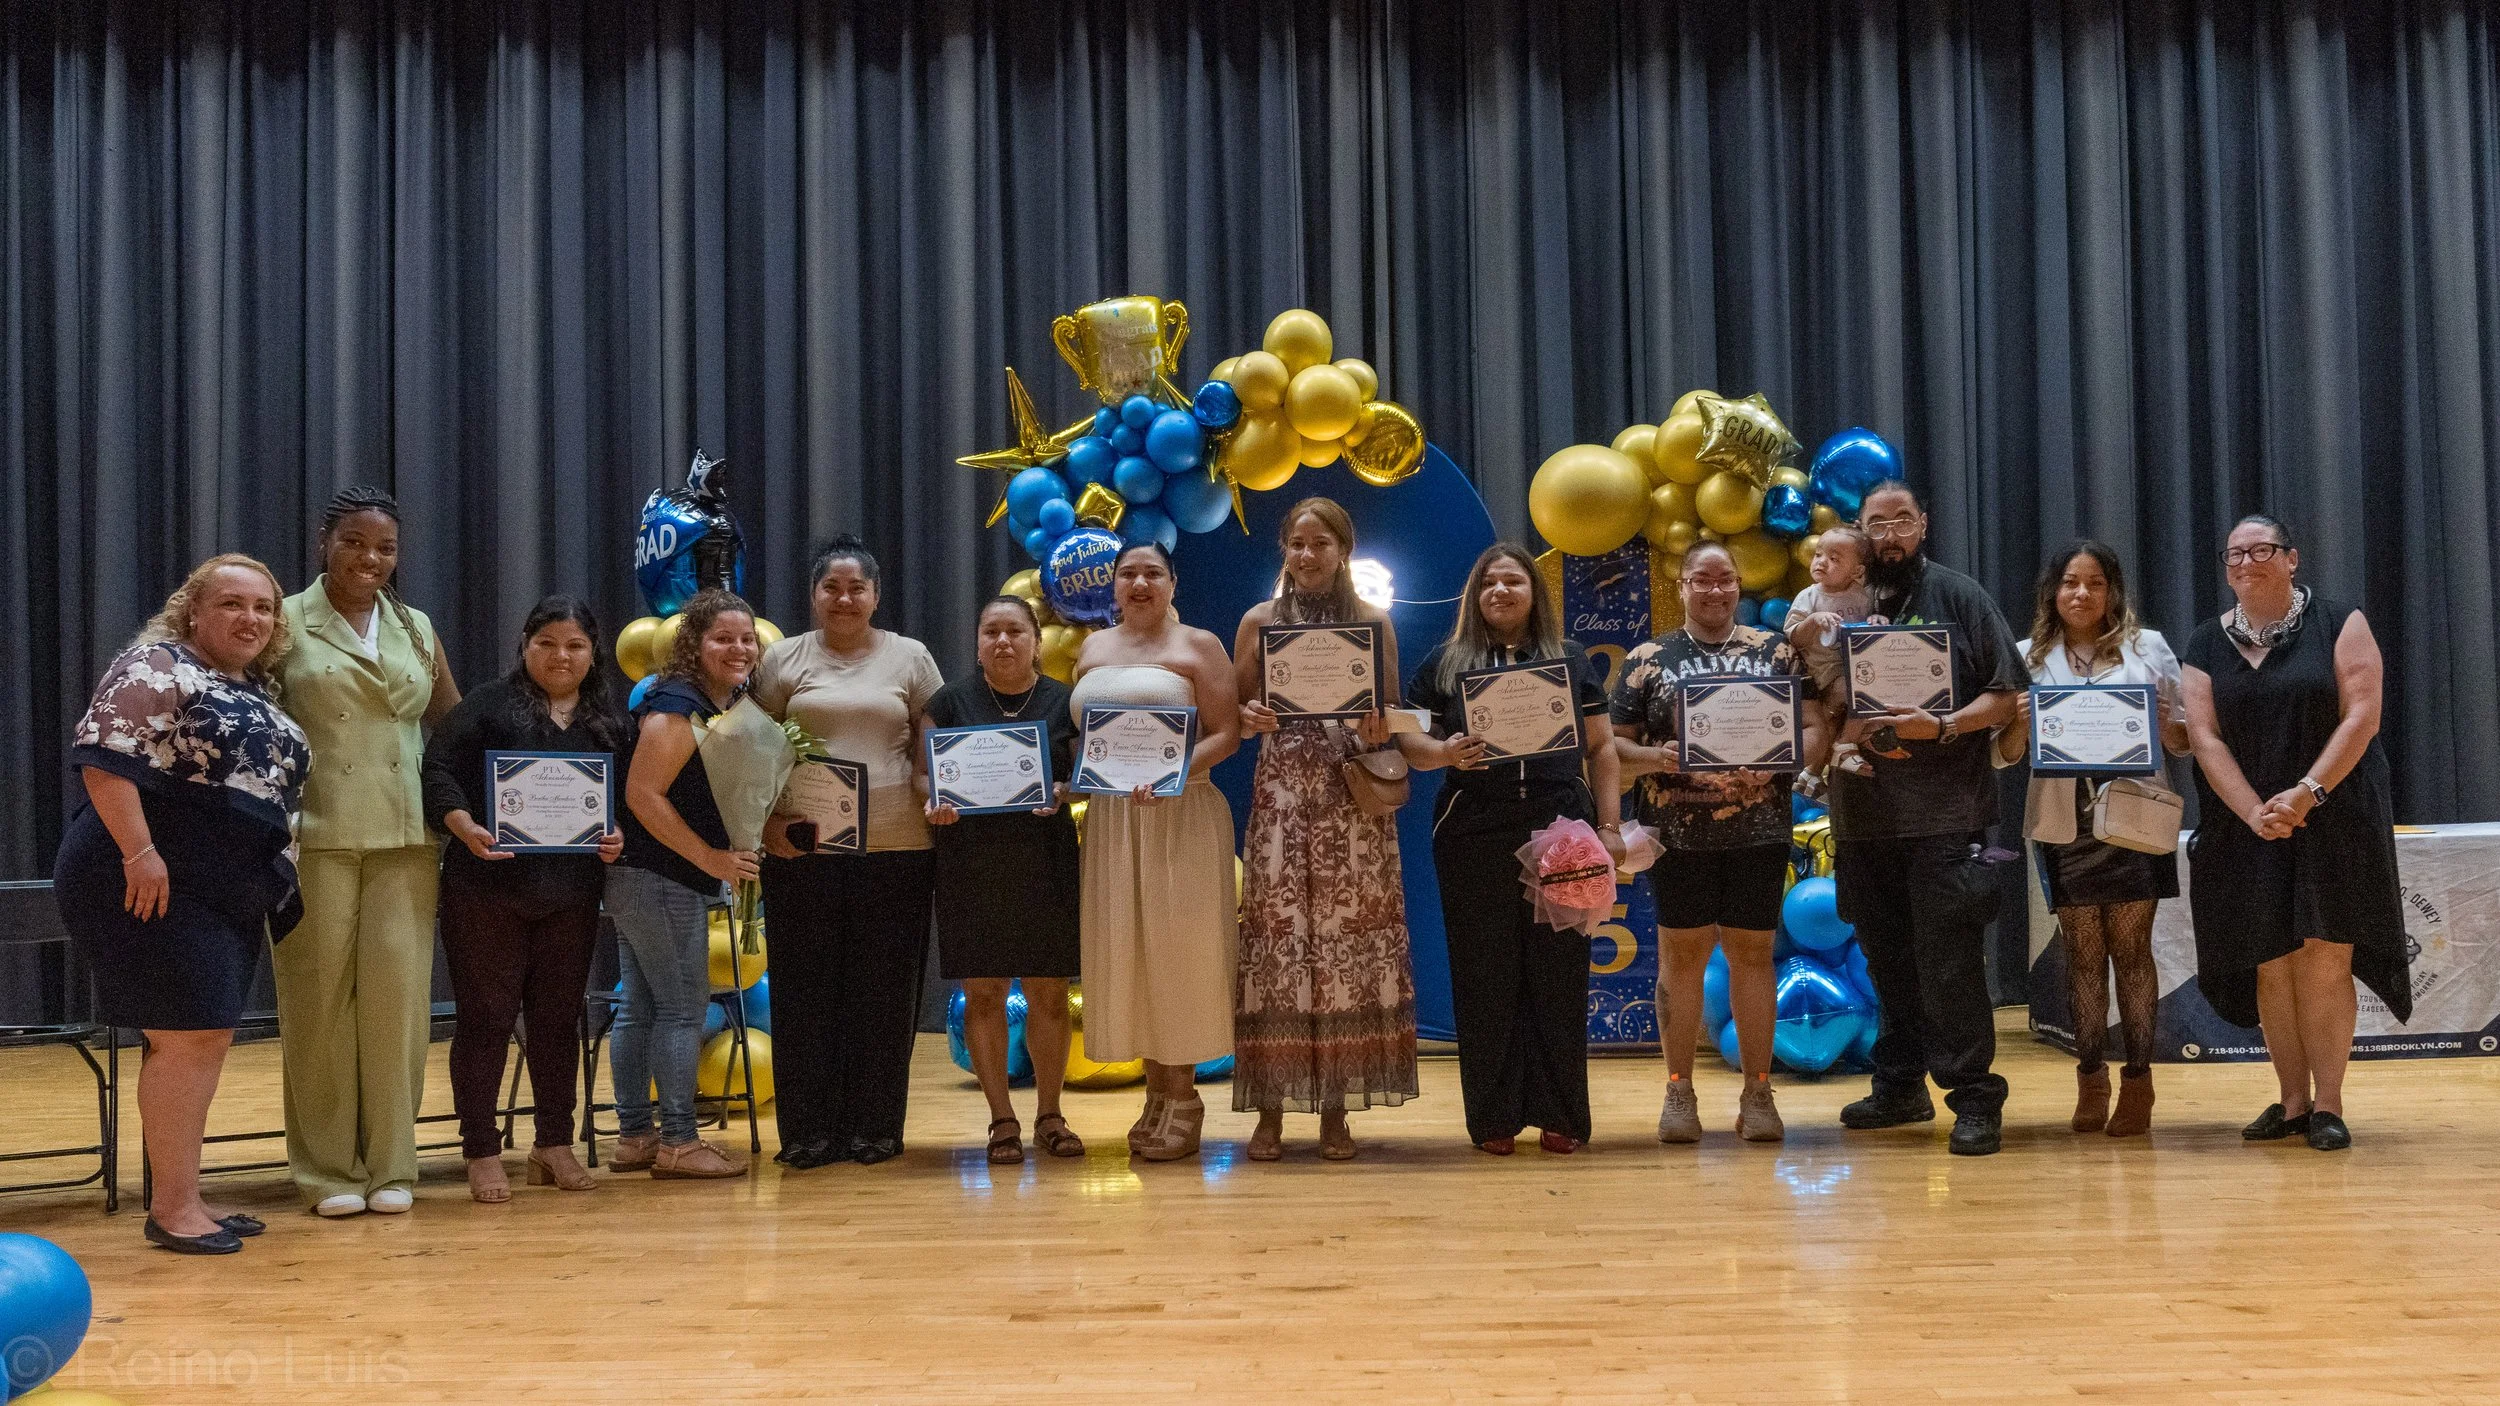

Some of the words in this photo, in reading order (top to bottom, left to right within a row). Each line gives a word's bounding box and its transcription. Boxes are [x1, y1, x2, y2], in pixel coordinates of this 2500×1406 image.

[1722, 416, 1778, 455] GRAD
[1574, 613, 1622, 631] Class
[1627, 613, 1648, 638] of
[1661, 655, 1772, 684] AALIYAH
[976, 737, 994, 745] PTA
[543, 766, 561, 774] PTA
[2410, 893, 2441, 924] DEWEY
[2411, 970, 2428, 990] TODAY
[2412, 972, 2438, 1002] OMORROW
